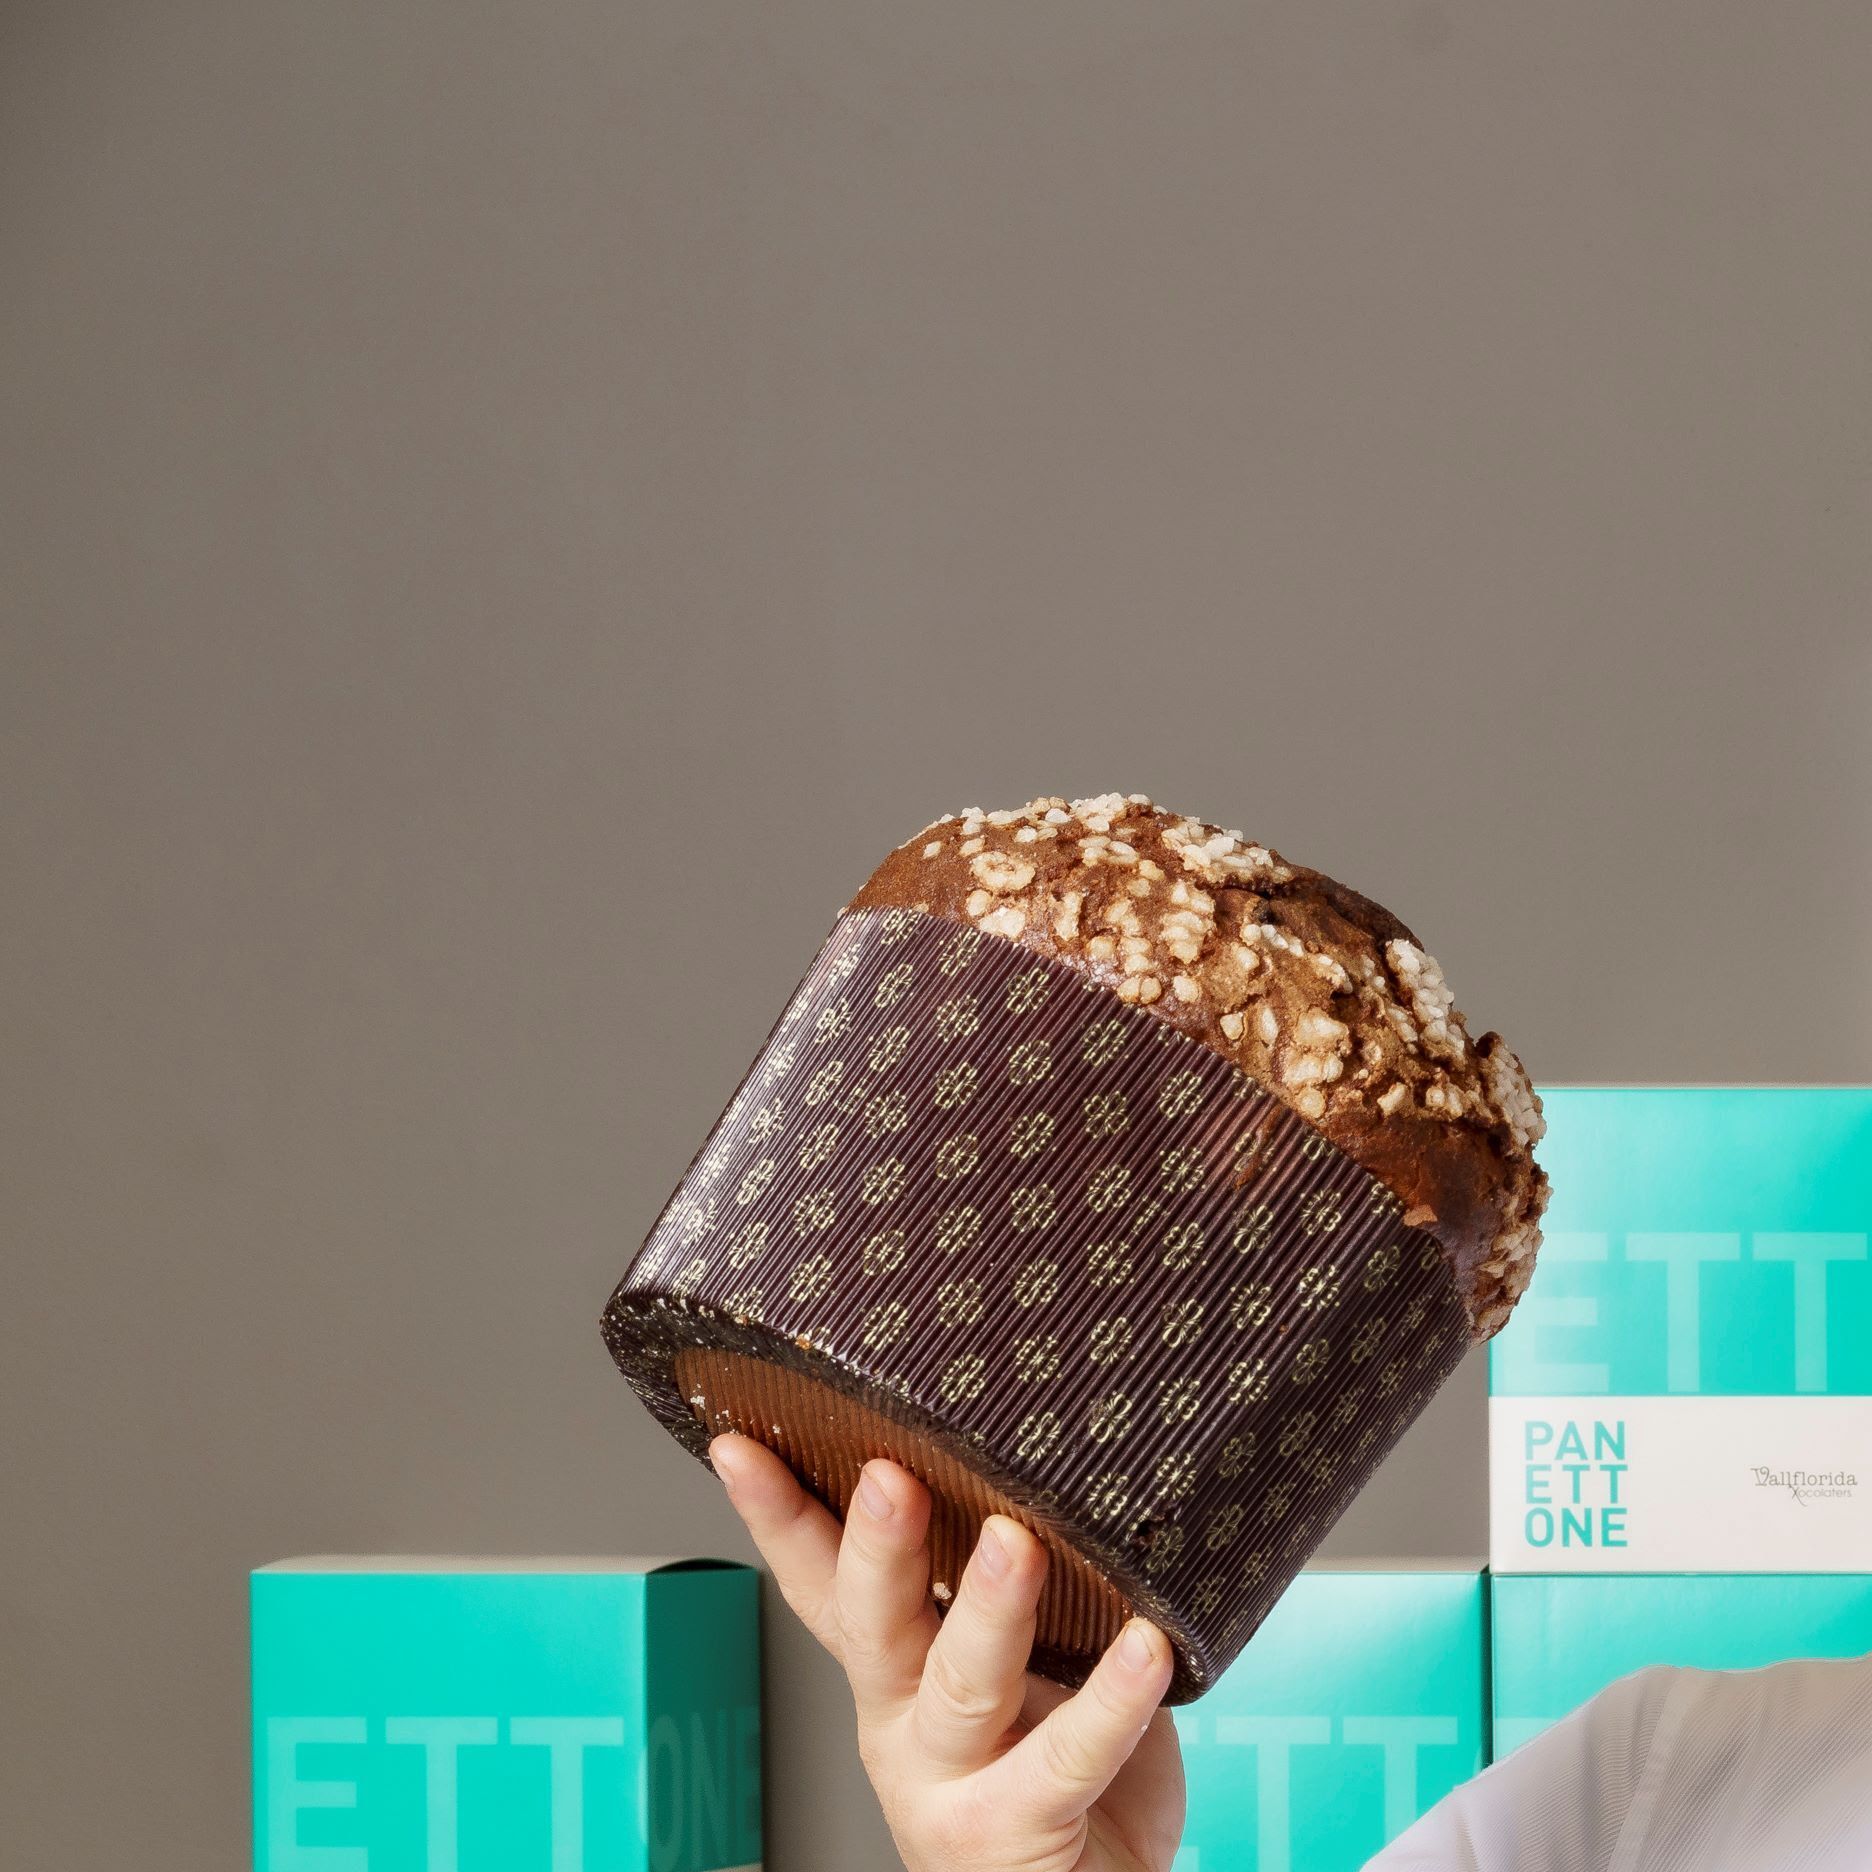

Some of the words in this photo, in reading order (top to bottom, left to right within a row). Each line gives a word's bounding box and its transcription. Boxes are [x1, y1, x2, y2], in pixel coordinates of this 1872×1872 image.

[1515, 1232, 1867, 1392] ETT
[1524, 1421, 1625, 1460] PAN
[1525, 1465, 1628, 1503] ETT
[1750, 1466, 1858, 1489] Vallflorida
[1524, 1508, 1628, 1548] ONE
